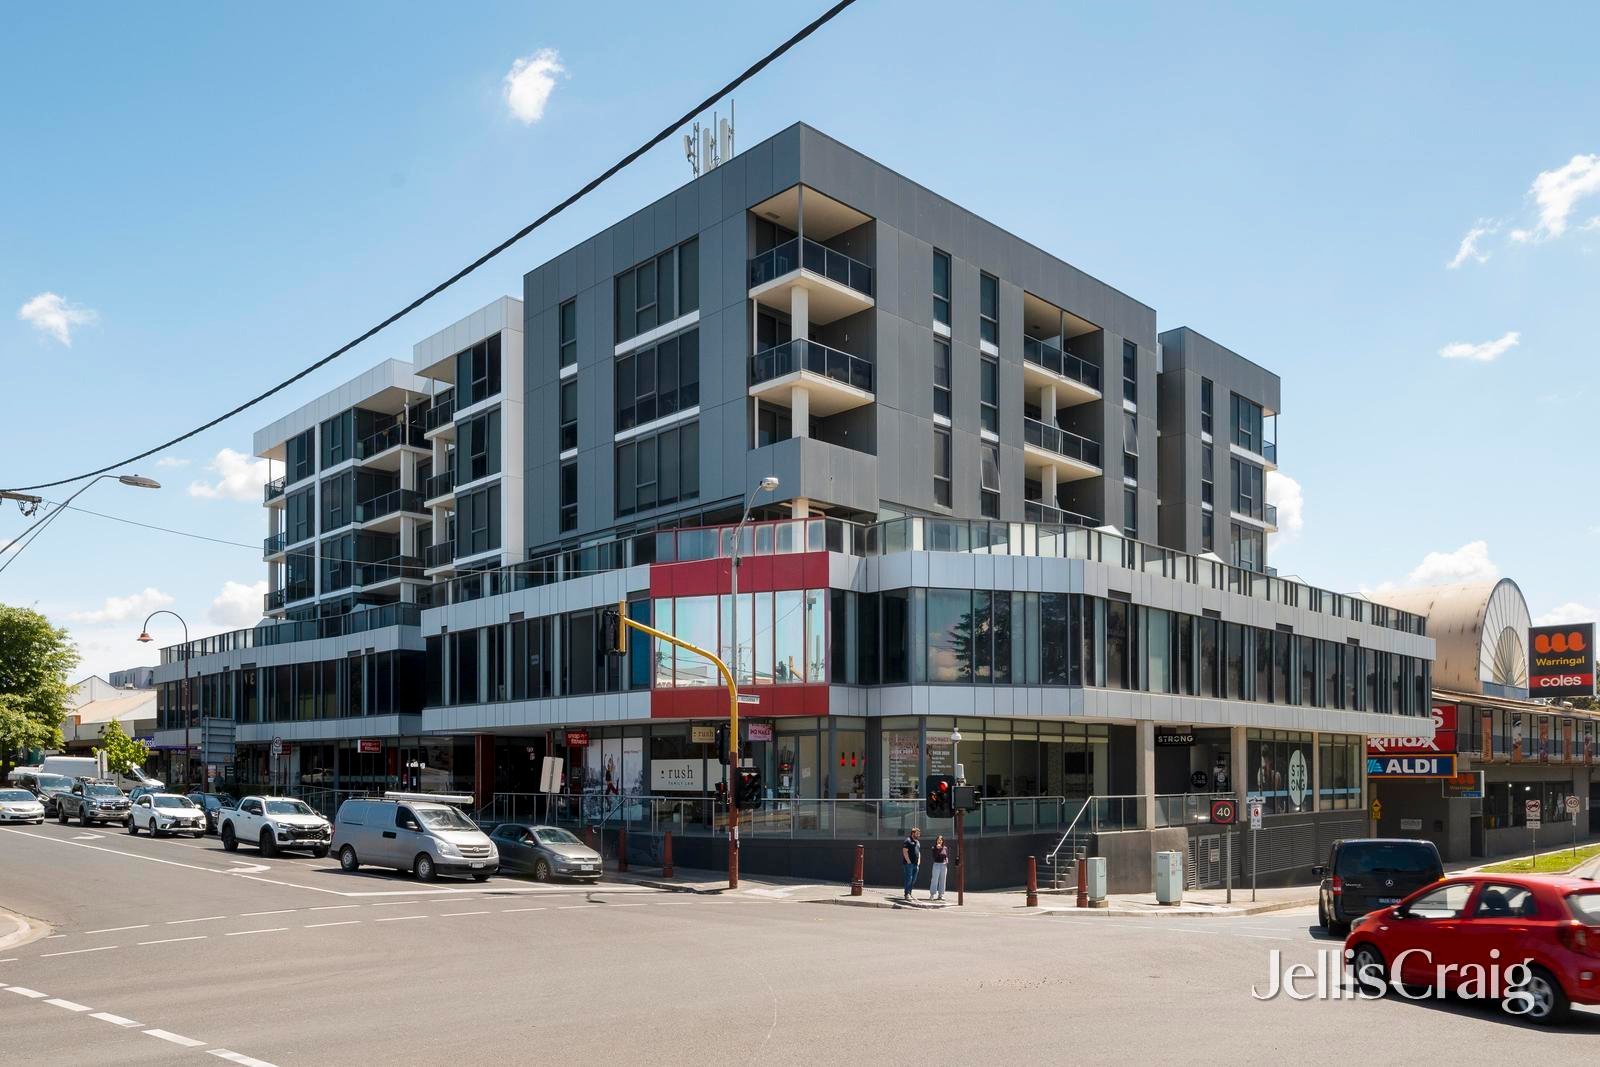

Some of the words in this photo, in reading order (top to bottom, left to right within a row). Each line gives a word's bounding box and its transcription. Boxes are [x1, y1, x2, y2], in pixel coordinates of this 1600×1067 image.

[1536, 656, 1585, 667] Warringal
[1540, 675, 1582, 687] coles
[698, 729, 714, 737] rush
[1158, 735, 1194, 743] STRONG
[668, 764, 693, 779] rush
[1386, 759, 1438, 773] ALDI
[1216, 807, 1231, 817] 40
